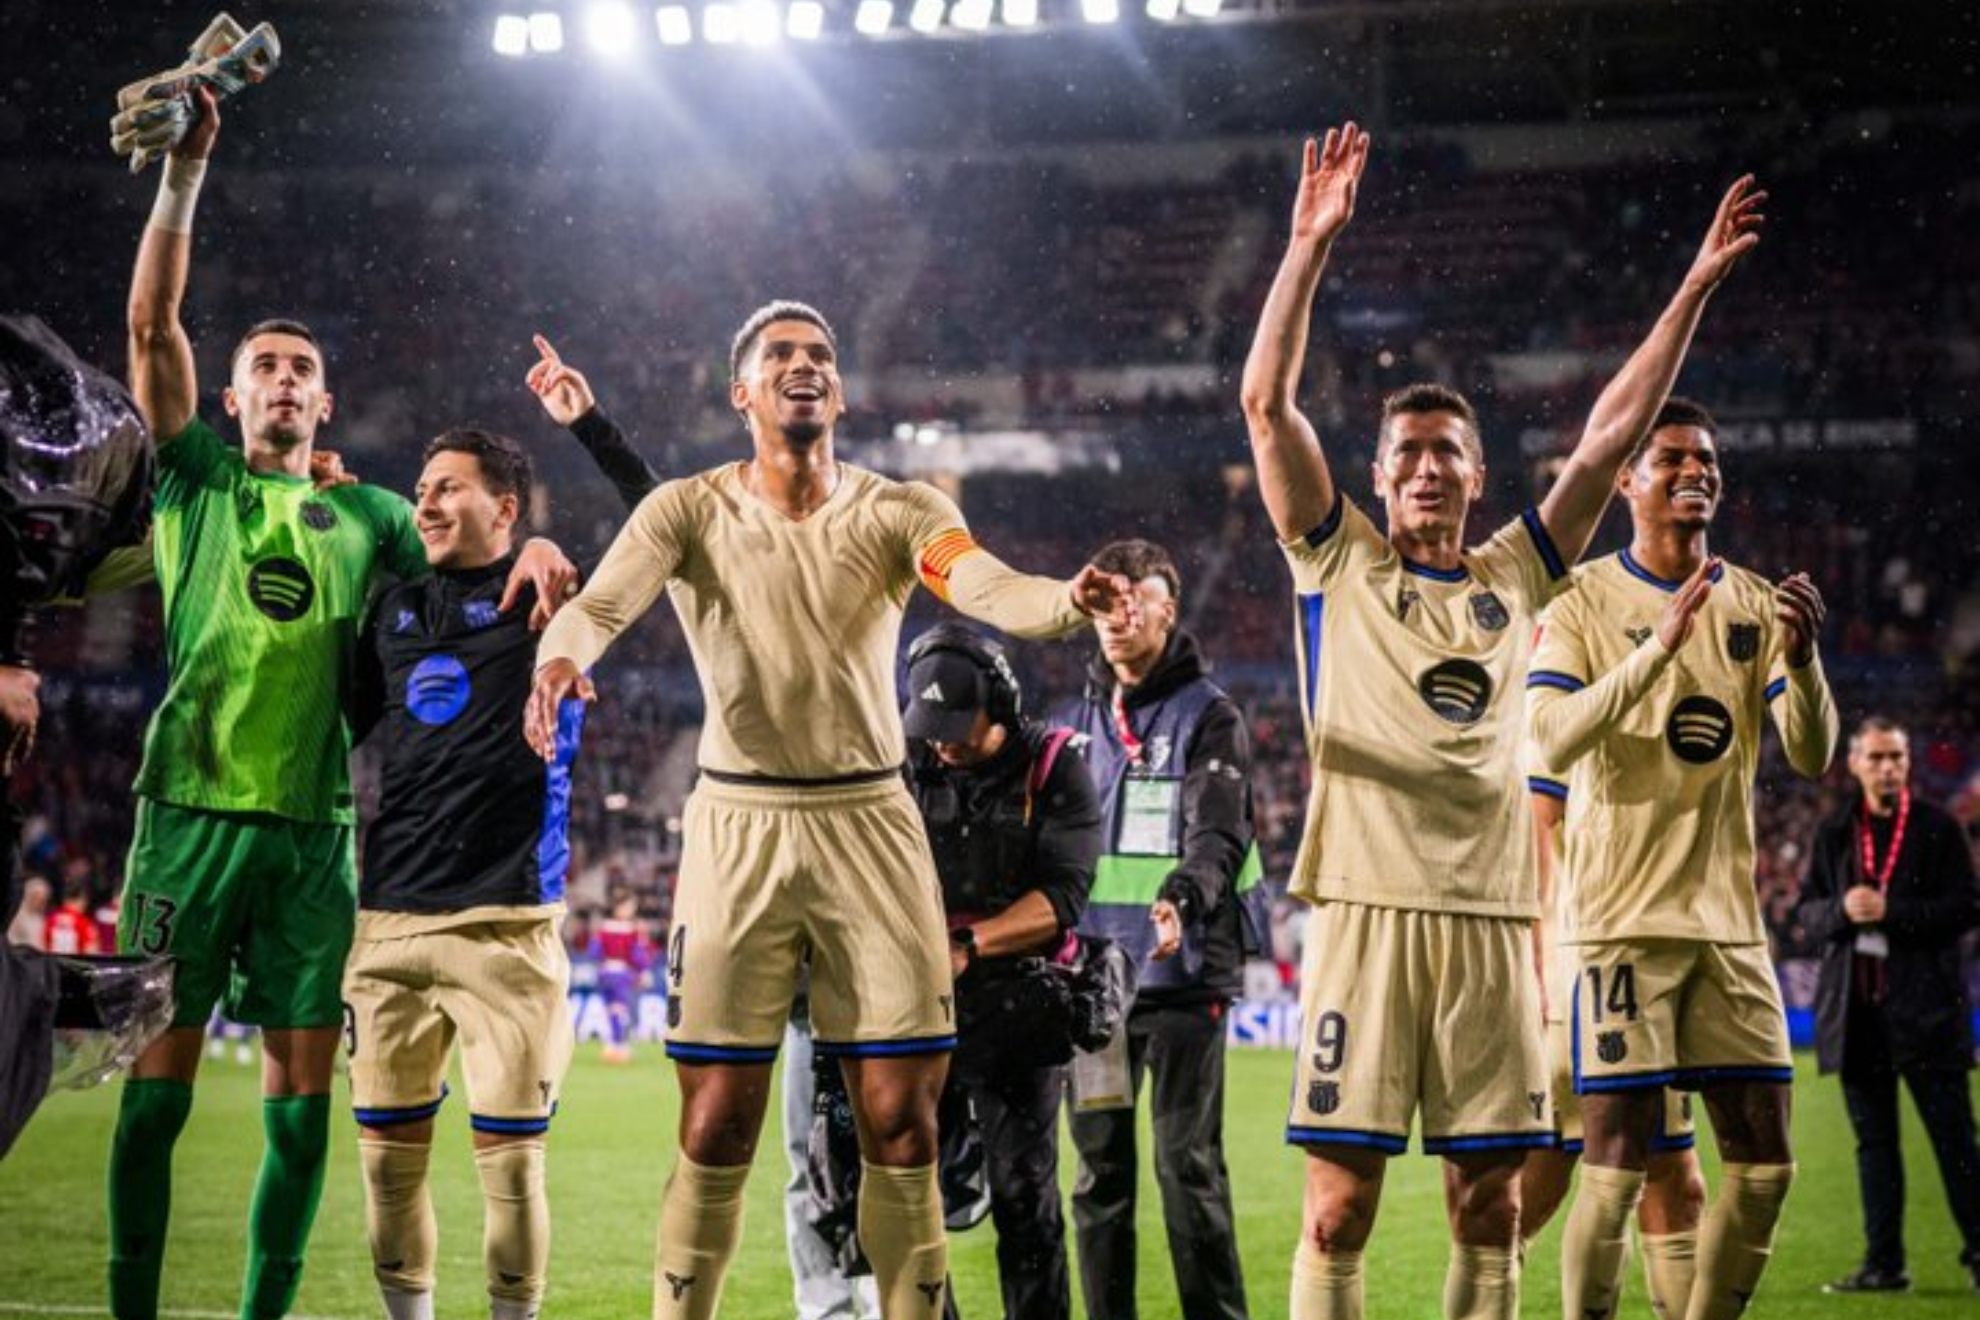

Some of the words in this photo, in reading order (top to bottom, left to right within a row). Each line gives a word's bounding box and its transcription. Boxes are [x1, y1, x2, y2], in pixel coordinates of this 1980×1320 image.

[129, 892, 177, 955] 13
[1586, 963, 1637, 1024] 14
[1313, 1009, 1347, 1074] 9
